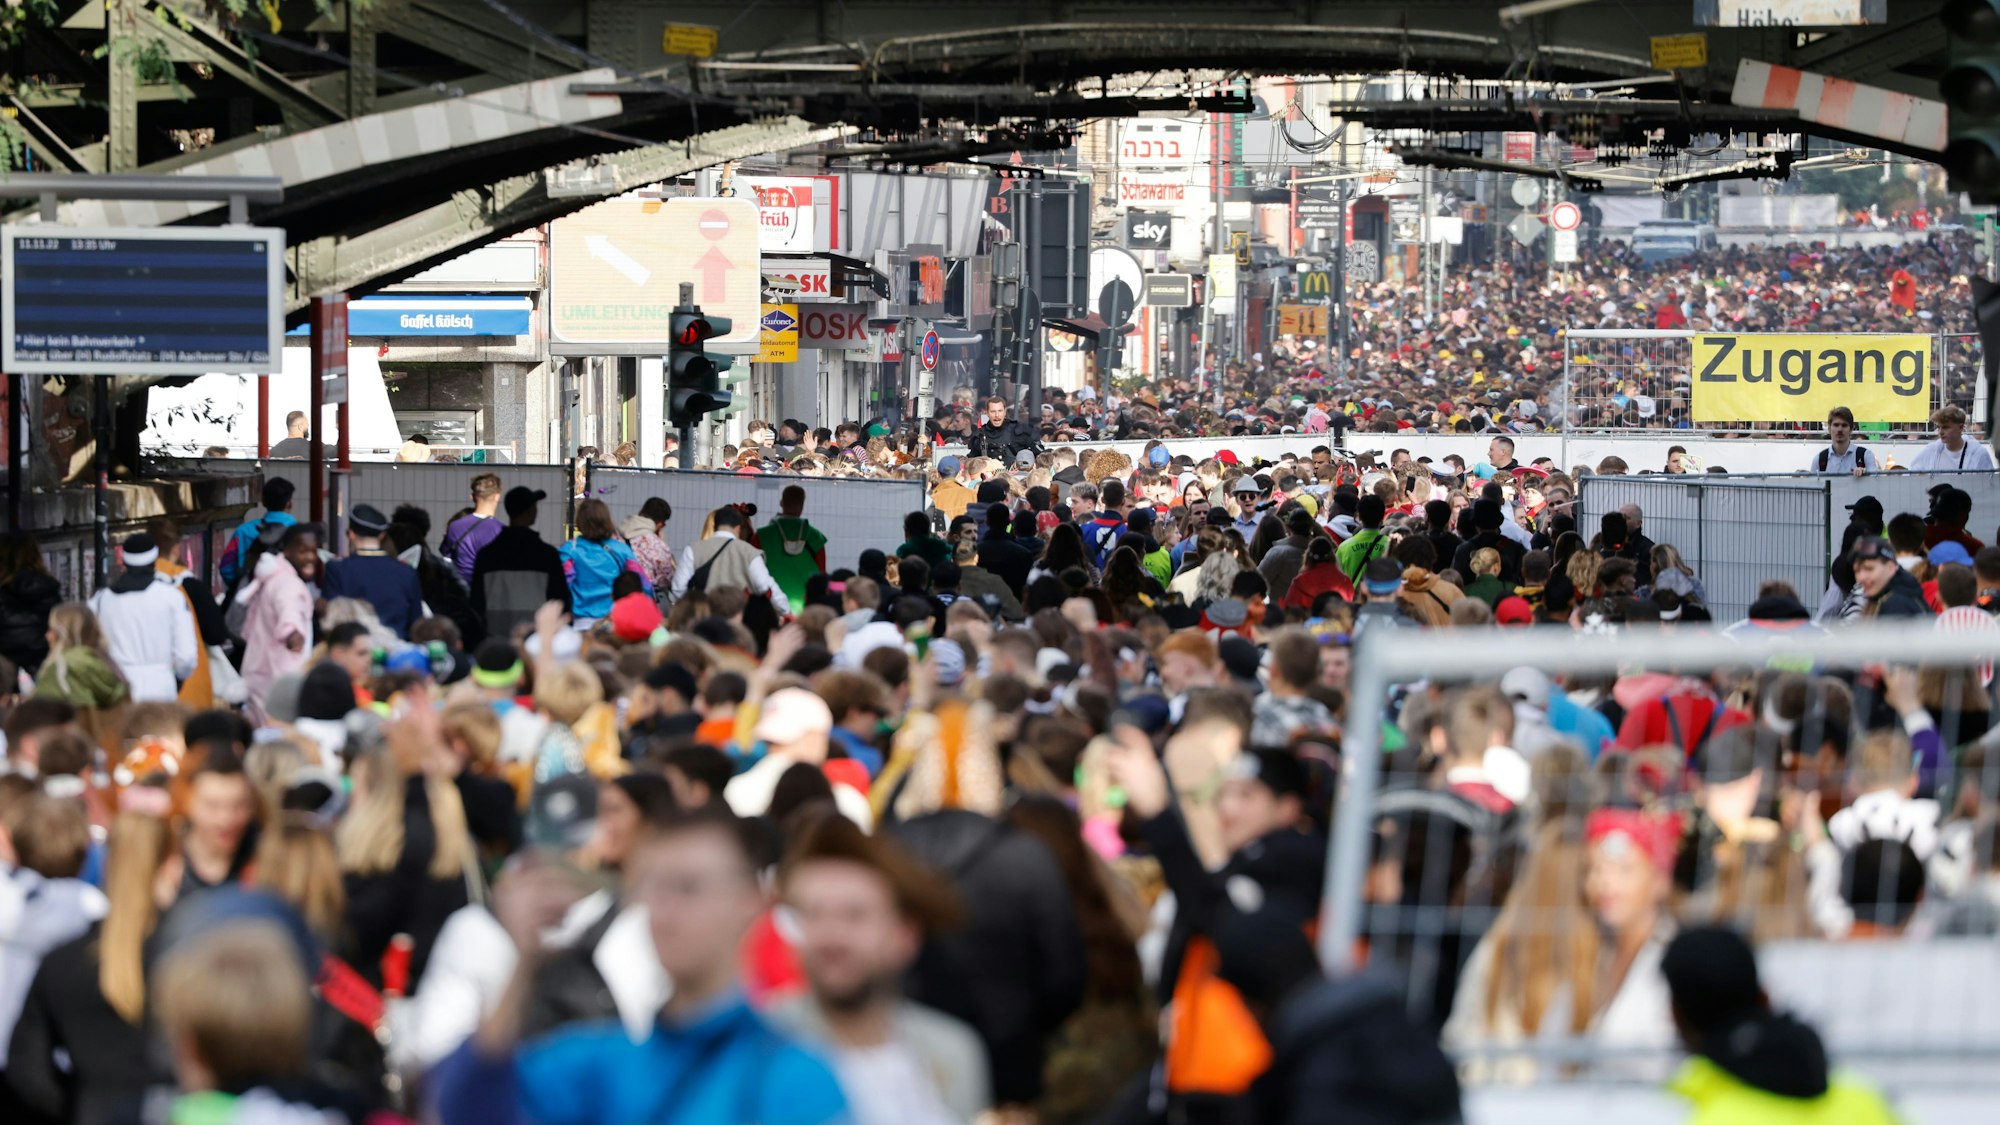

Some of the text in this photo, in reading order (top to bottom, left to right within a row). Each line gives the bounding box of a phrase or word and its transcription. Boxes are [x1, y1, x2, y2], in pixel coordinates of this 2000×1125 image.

[1124, 141, 1181, 158] ברכה
[1121, 177, 1184, 200] Schawarma
[760, 210, 789, 227] früh
[1133, 221, 1168, 242] sky
[400, 313, 473, 329] Gaffel Kölsch
[561, 305, 669, 320] UMLEITUNG
[763, 317, 791, 325] Euronet
[798, 313, 869, 340] IOSK
[883, 332, 899, 354] OSK
[1700, 337, 1923, 396] Zugang
